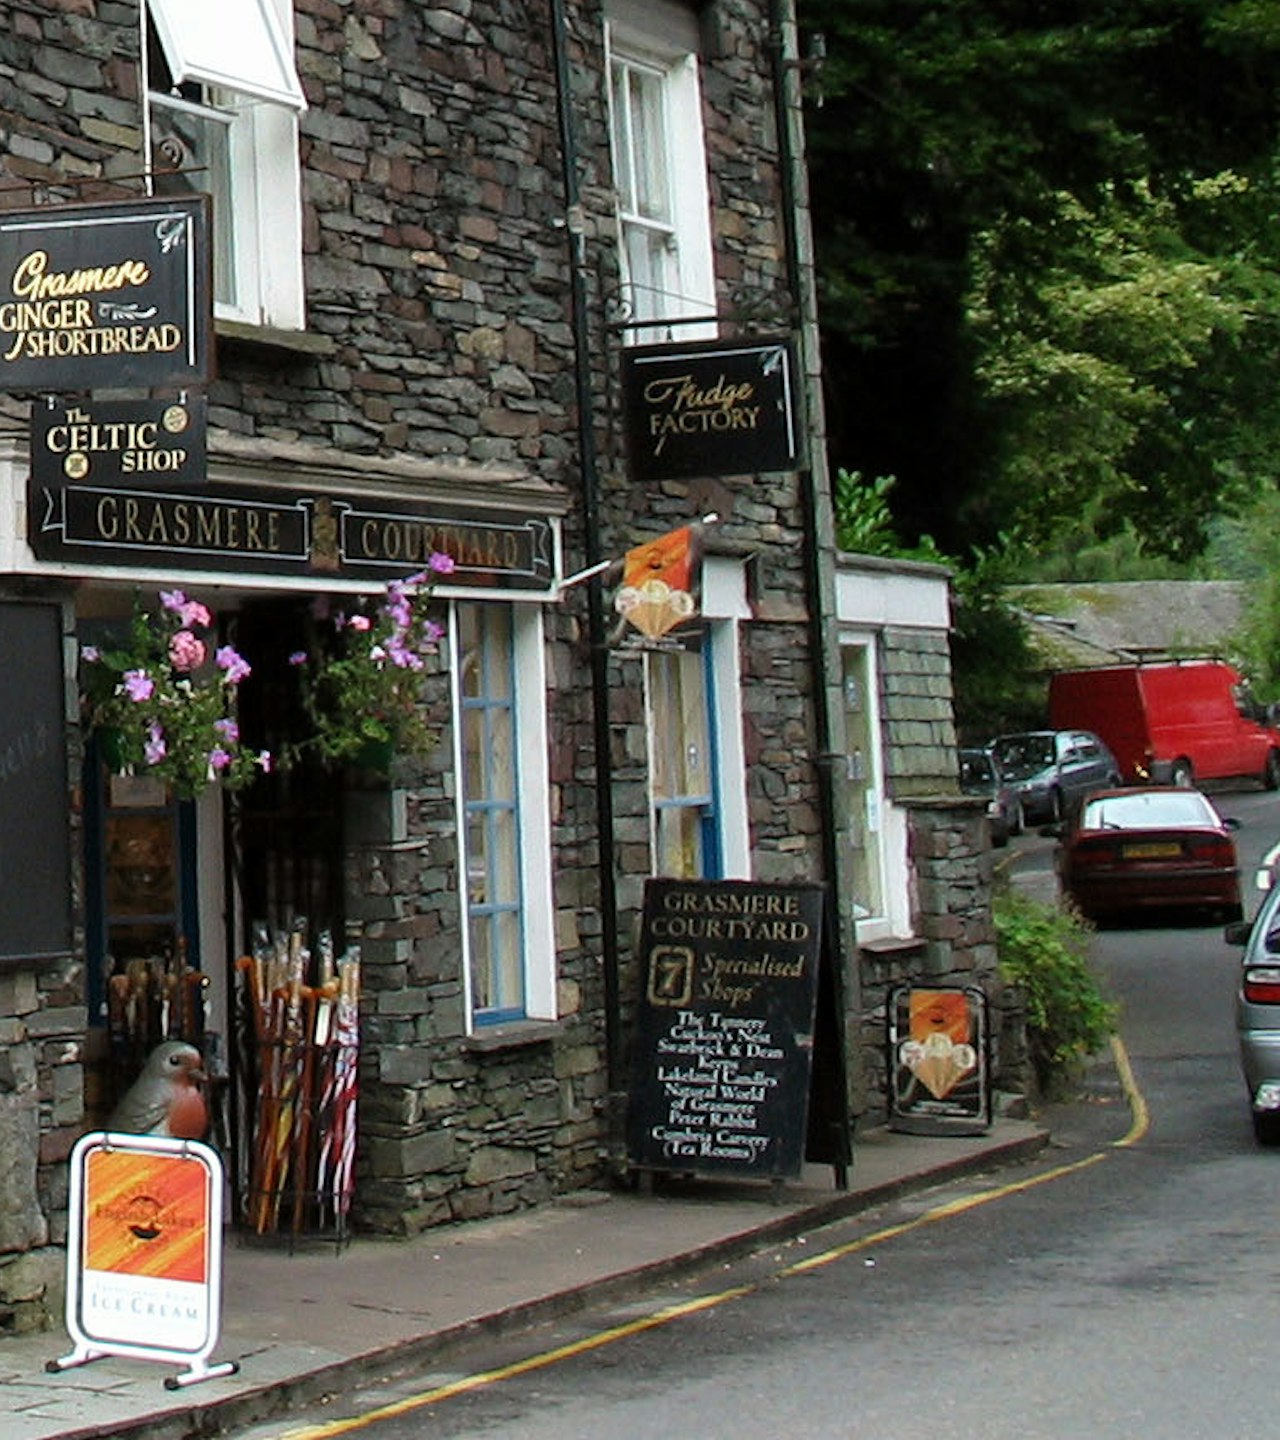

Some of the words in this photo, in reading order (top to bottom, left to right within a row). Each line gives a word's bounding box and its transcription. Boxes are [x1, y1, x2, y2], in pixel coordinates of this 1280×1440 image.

[13, 250, 151, 301] Grasmere
[26, 323, 182, 358] SHORTBREAD
[644, 373, 754, 411] Fudge
[650, 407, 760, 436] FACTORY
[46, 422, 159, 453] CELTIC
[122, 449, 188, 474] SHOP
[95, 495, 281, 551] GRASMERE
[361, 520, 519, 568] COURTYARD
[664, 891, 800, 917] GRASMERE
[650, 917, 810, 942] COURTYARD
[658, 959, 681, 996] 7
[677, 1011, 704, 1026] The
